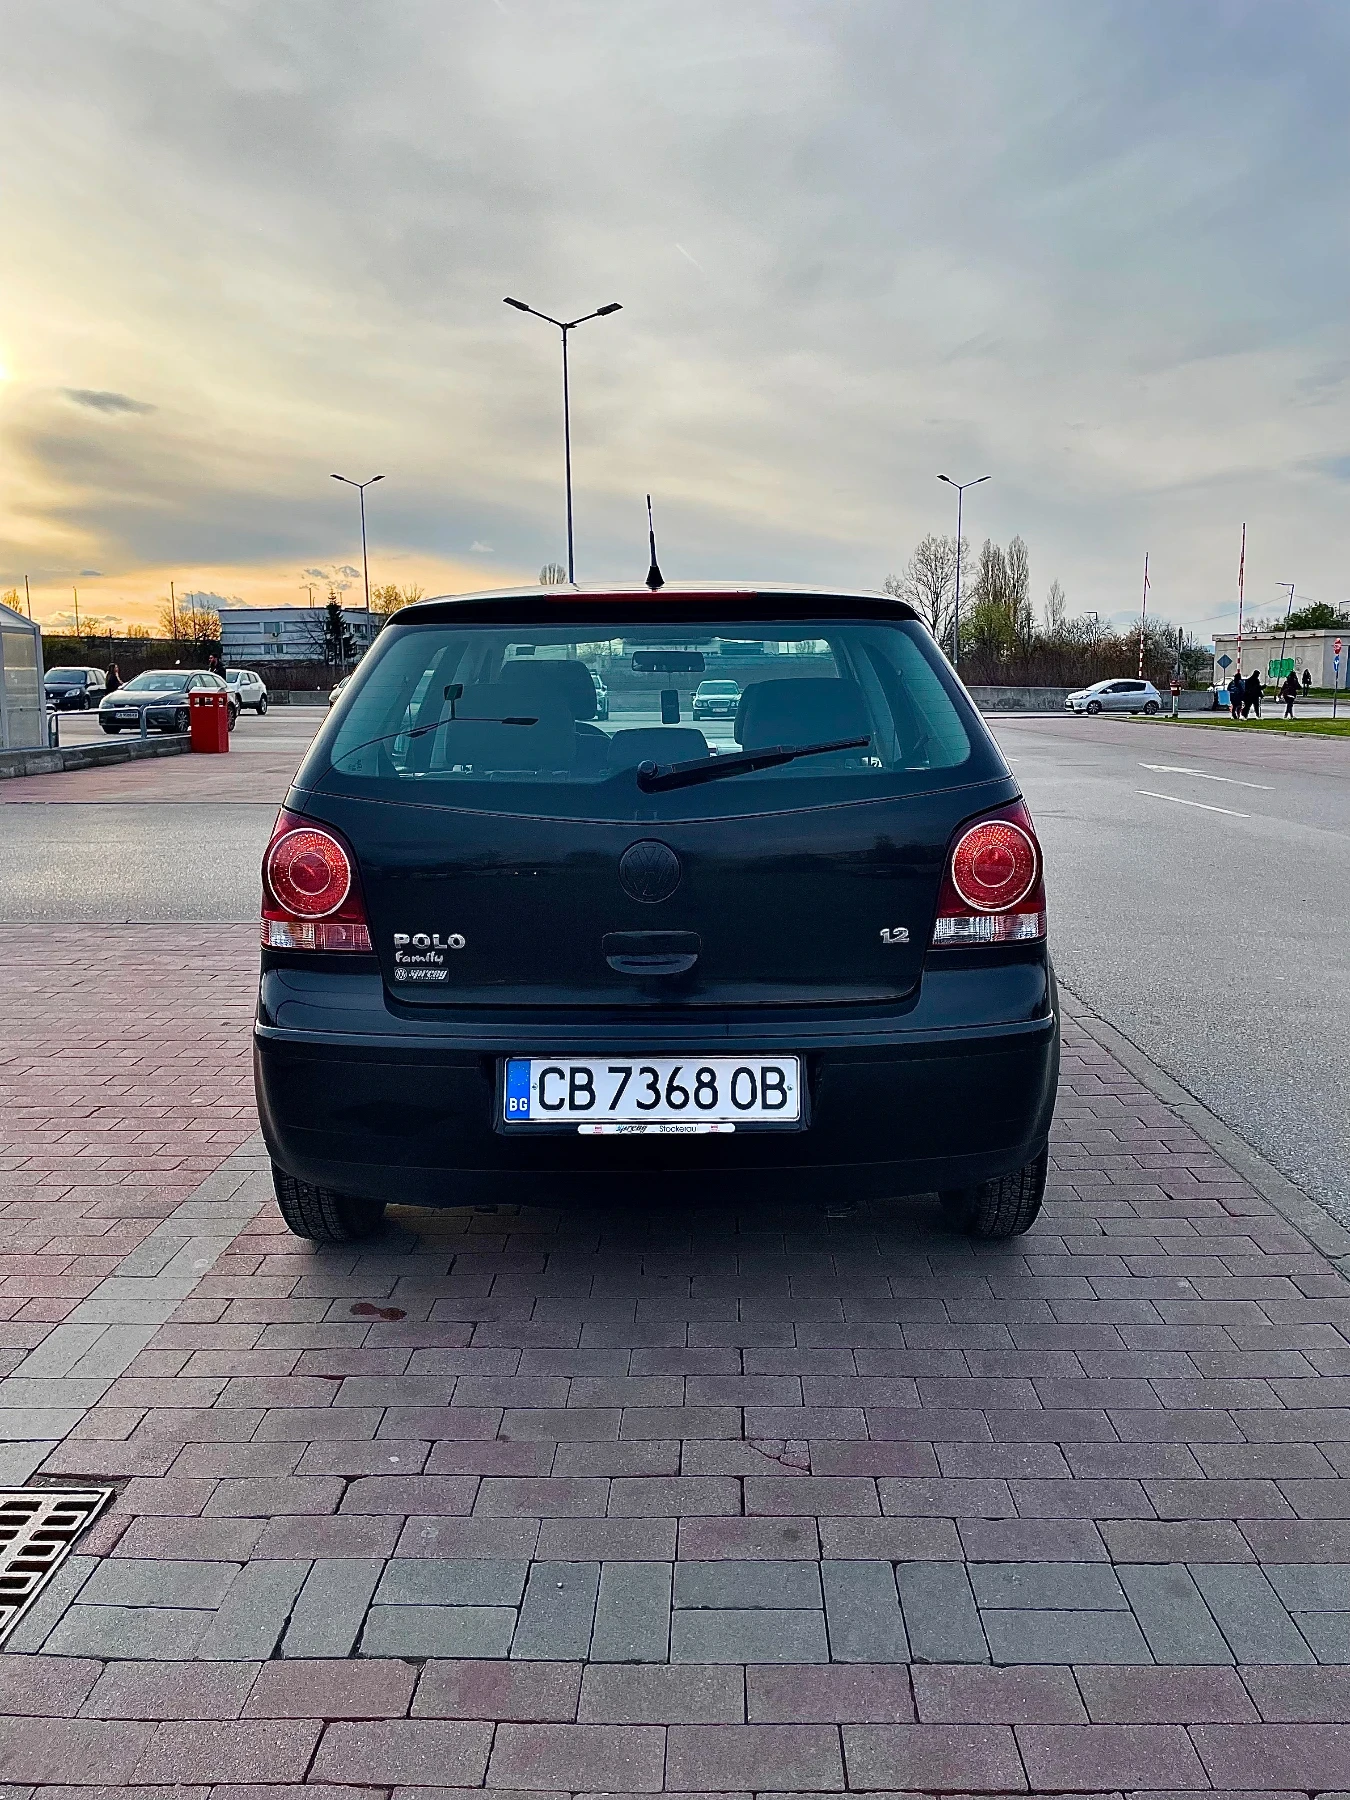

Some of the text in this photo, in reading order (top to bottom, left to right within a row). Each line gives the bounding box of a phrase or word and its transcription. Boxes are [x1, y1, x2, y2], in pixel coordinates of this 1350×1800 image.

[393, 933, 466, 949] POLO
[509, 1098, 528, 1111] BG
[538, 1066, 597, 1111] CB
[607, 1066, 719, 1111] 7368
[659, 1125, 697, 1133] Stockerau
